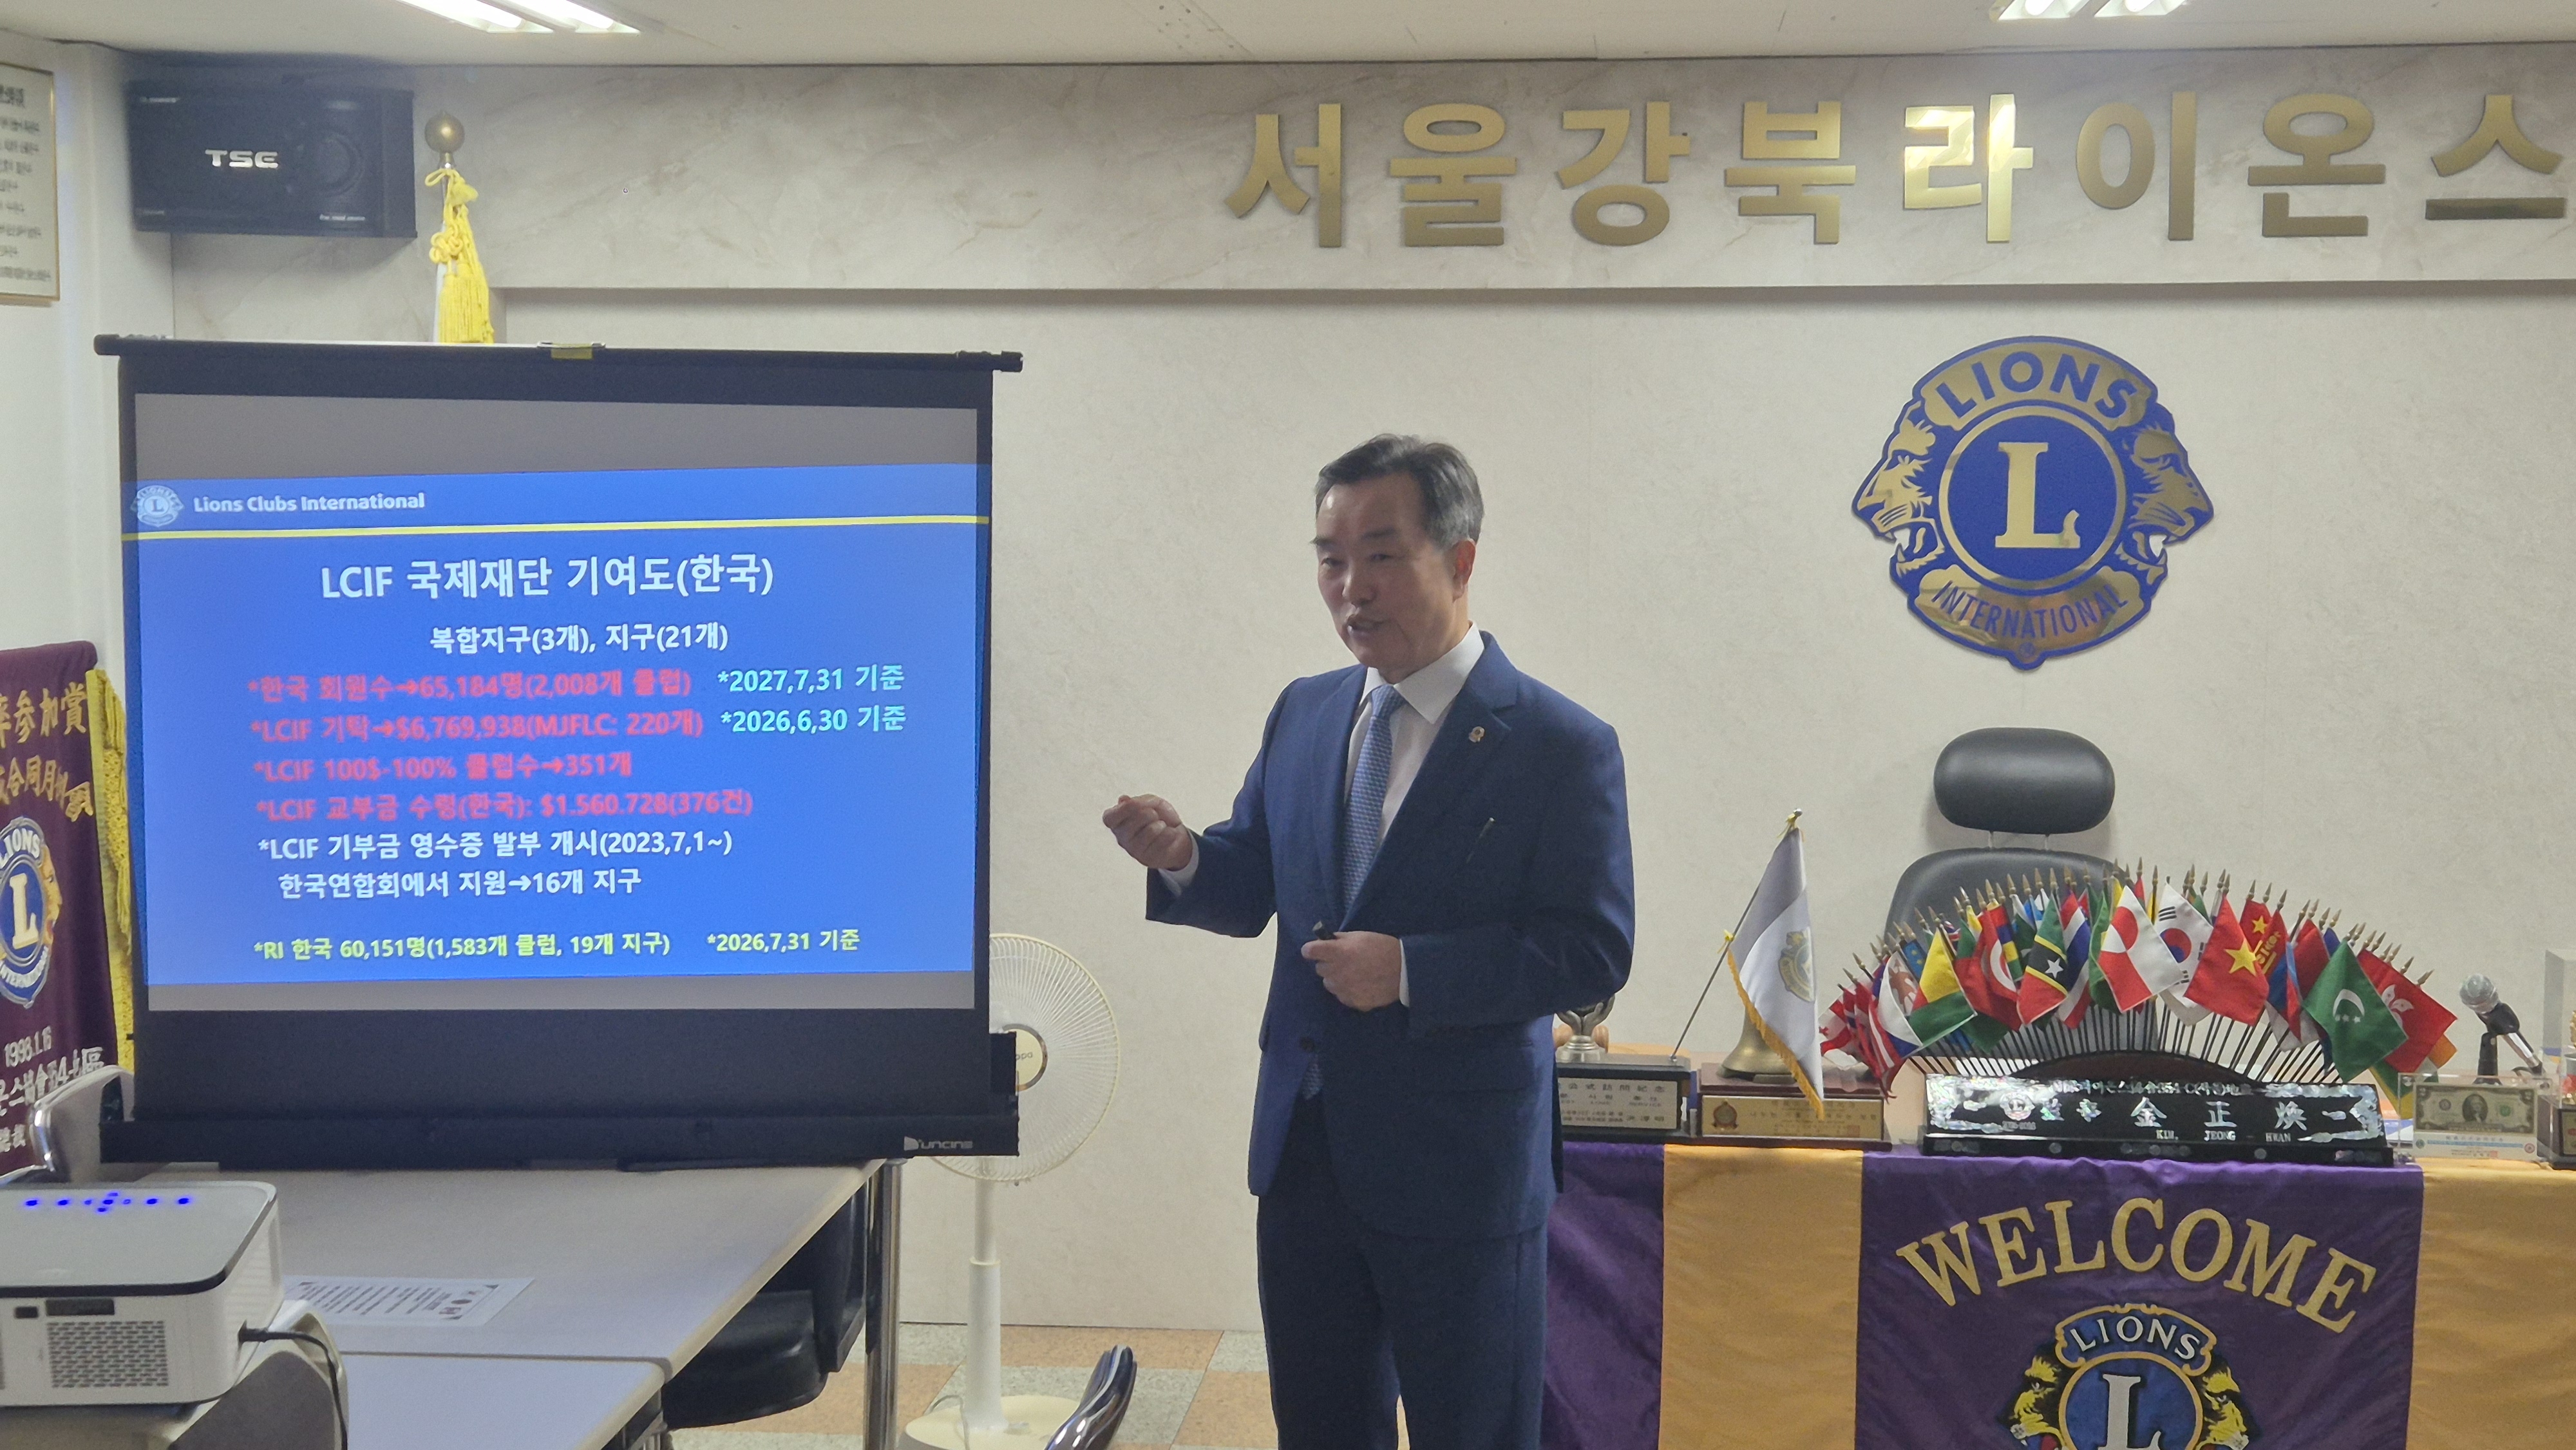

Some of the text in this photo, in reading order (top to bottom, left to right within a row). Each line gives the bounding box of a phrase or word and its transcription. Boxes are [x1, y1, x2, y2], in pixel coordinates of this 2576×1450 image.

[205, 149, 278, 168] TSE
[1224, 91, 2566, 248] 서울강북라이온스
[1935, 351, 2137, 419] LIONS
[194, 493, 425, 513] Lions Clubs International
[1995, 442, 2080, 548] L
[322, 552, 773, 599] LCIF 국제재단 기여도(한국)
[1931, 580, 2128, 639] INTERNATIONAL
[430, 621, 728, 654] 복합지구(3개), 지구(21개)
[856, 664, 904, 692] 기준
[858, 704, 906, 731] 기준
[328, 833, 401, 860] 기부금
[410, 831, 484, 858] 영수증
[493, 831, 542, 857] 발부
[551, 829, 732, 858] 개시(2023,7,1~)
[278, 870, 449, 899] 한국연합회에서
[594, 867, 641, 894] 지구
[291, 937, 333, 961] 한국
[340, 935, 508, 959] 60,151명(1,583개
[570, 933, 614, 956] 19개
[622, 931, 670, 956] 지구)
[819, 929, 860, 951] 기준
[2204, 1130, 2236, 1142] JEONG
[1896, 1198, 2376, 1333] WELCOME
[2070, 1316, 2199, 1361] LIONS
[2101, 1373, 2163, 1450] L
